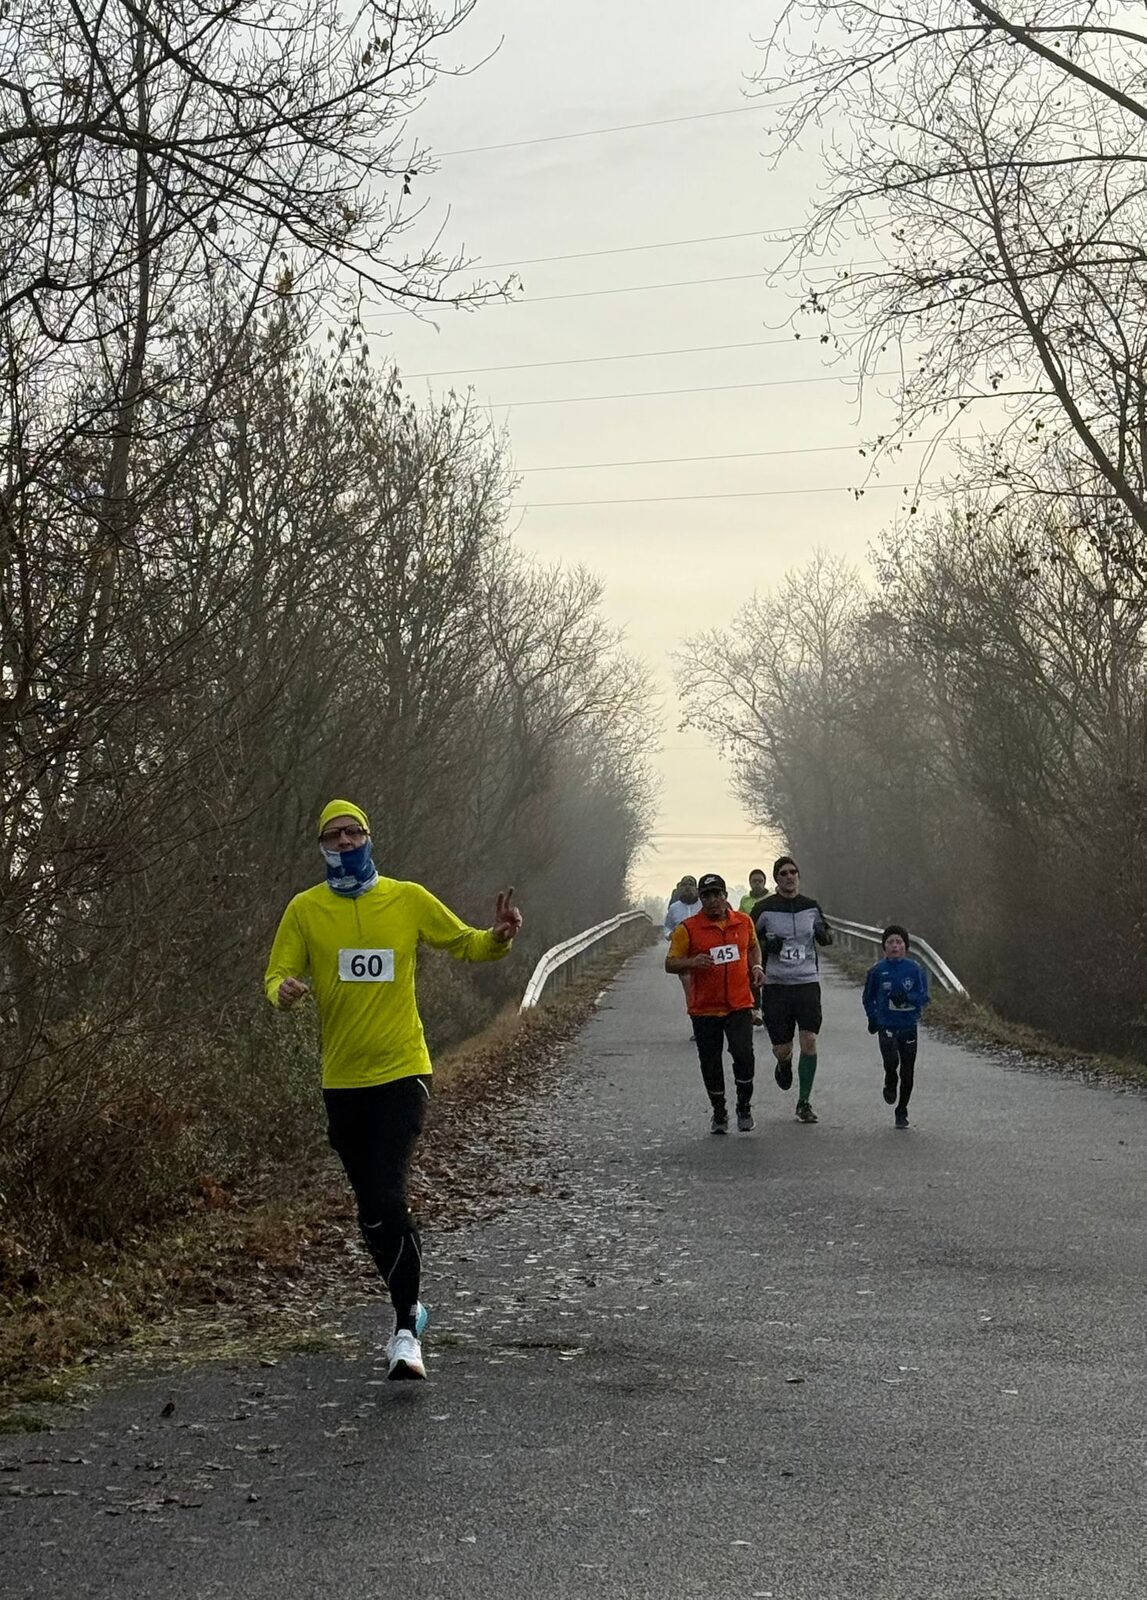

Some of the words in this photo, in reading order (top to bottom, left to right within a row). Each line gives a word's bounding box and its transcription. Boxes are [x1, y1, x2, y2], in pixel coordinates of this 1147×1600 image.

[717, 947, 733, 960] 45
[785, 949, 800, 960] 14
[351, 955, 383, 977] 60
